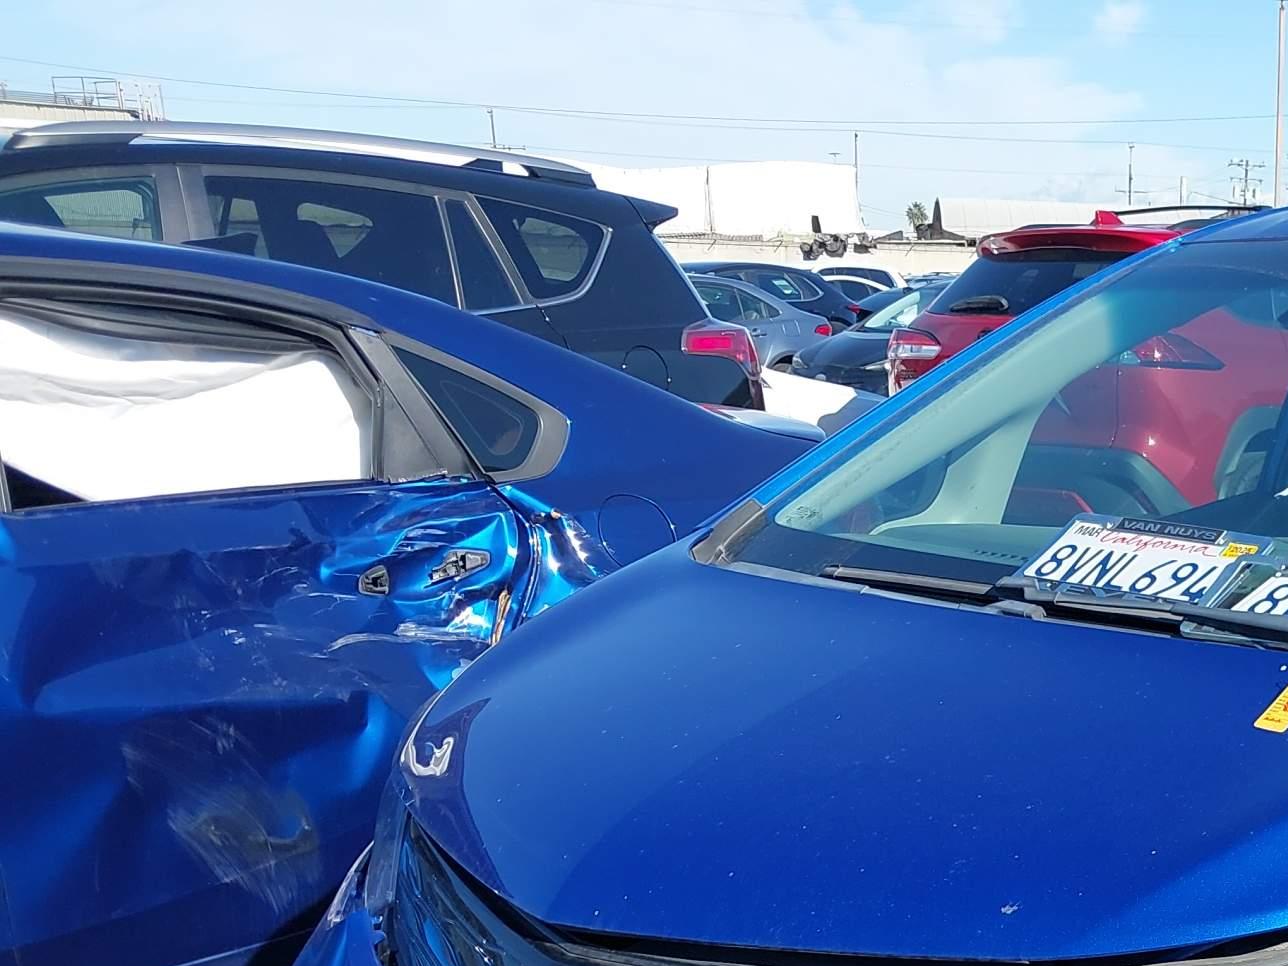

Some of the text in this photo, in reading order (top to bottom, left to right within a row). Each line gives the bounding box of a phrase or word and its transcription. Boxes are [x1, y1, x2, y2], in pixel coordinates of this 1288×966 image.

[1074, 524, 1102, 538] MAR
[1122, 519, 1217, 541] VAN NUYS
[1100, 530, 1217, 558] California
[1034, 543, 1219, 603] 8VNL694
